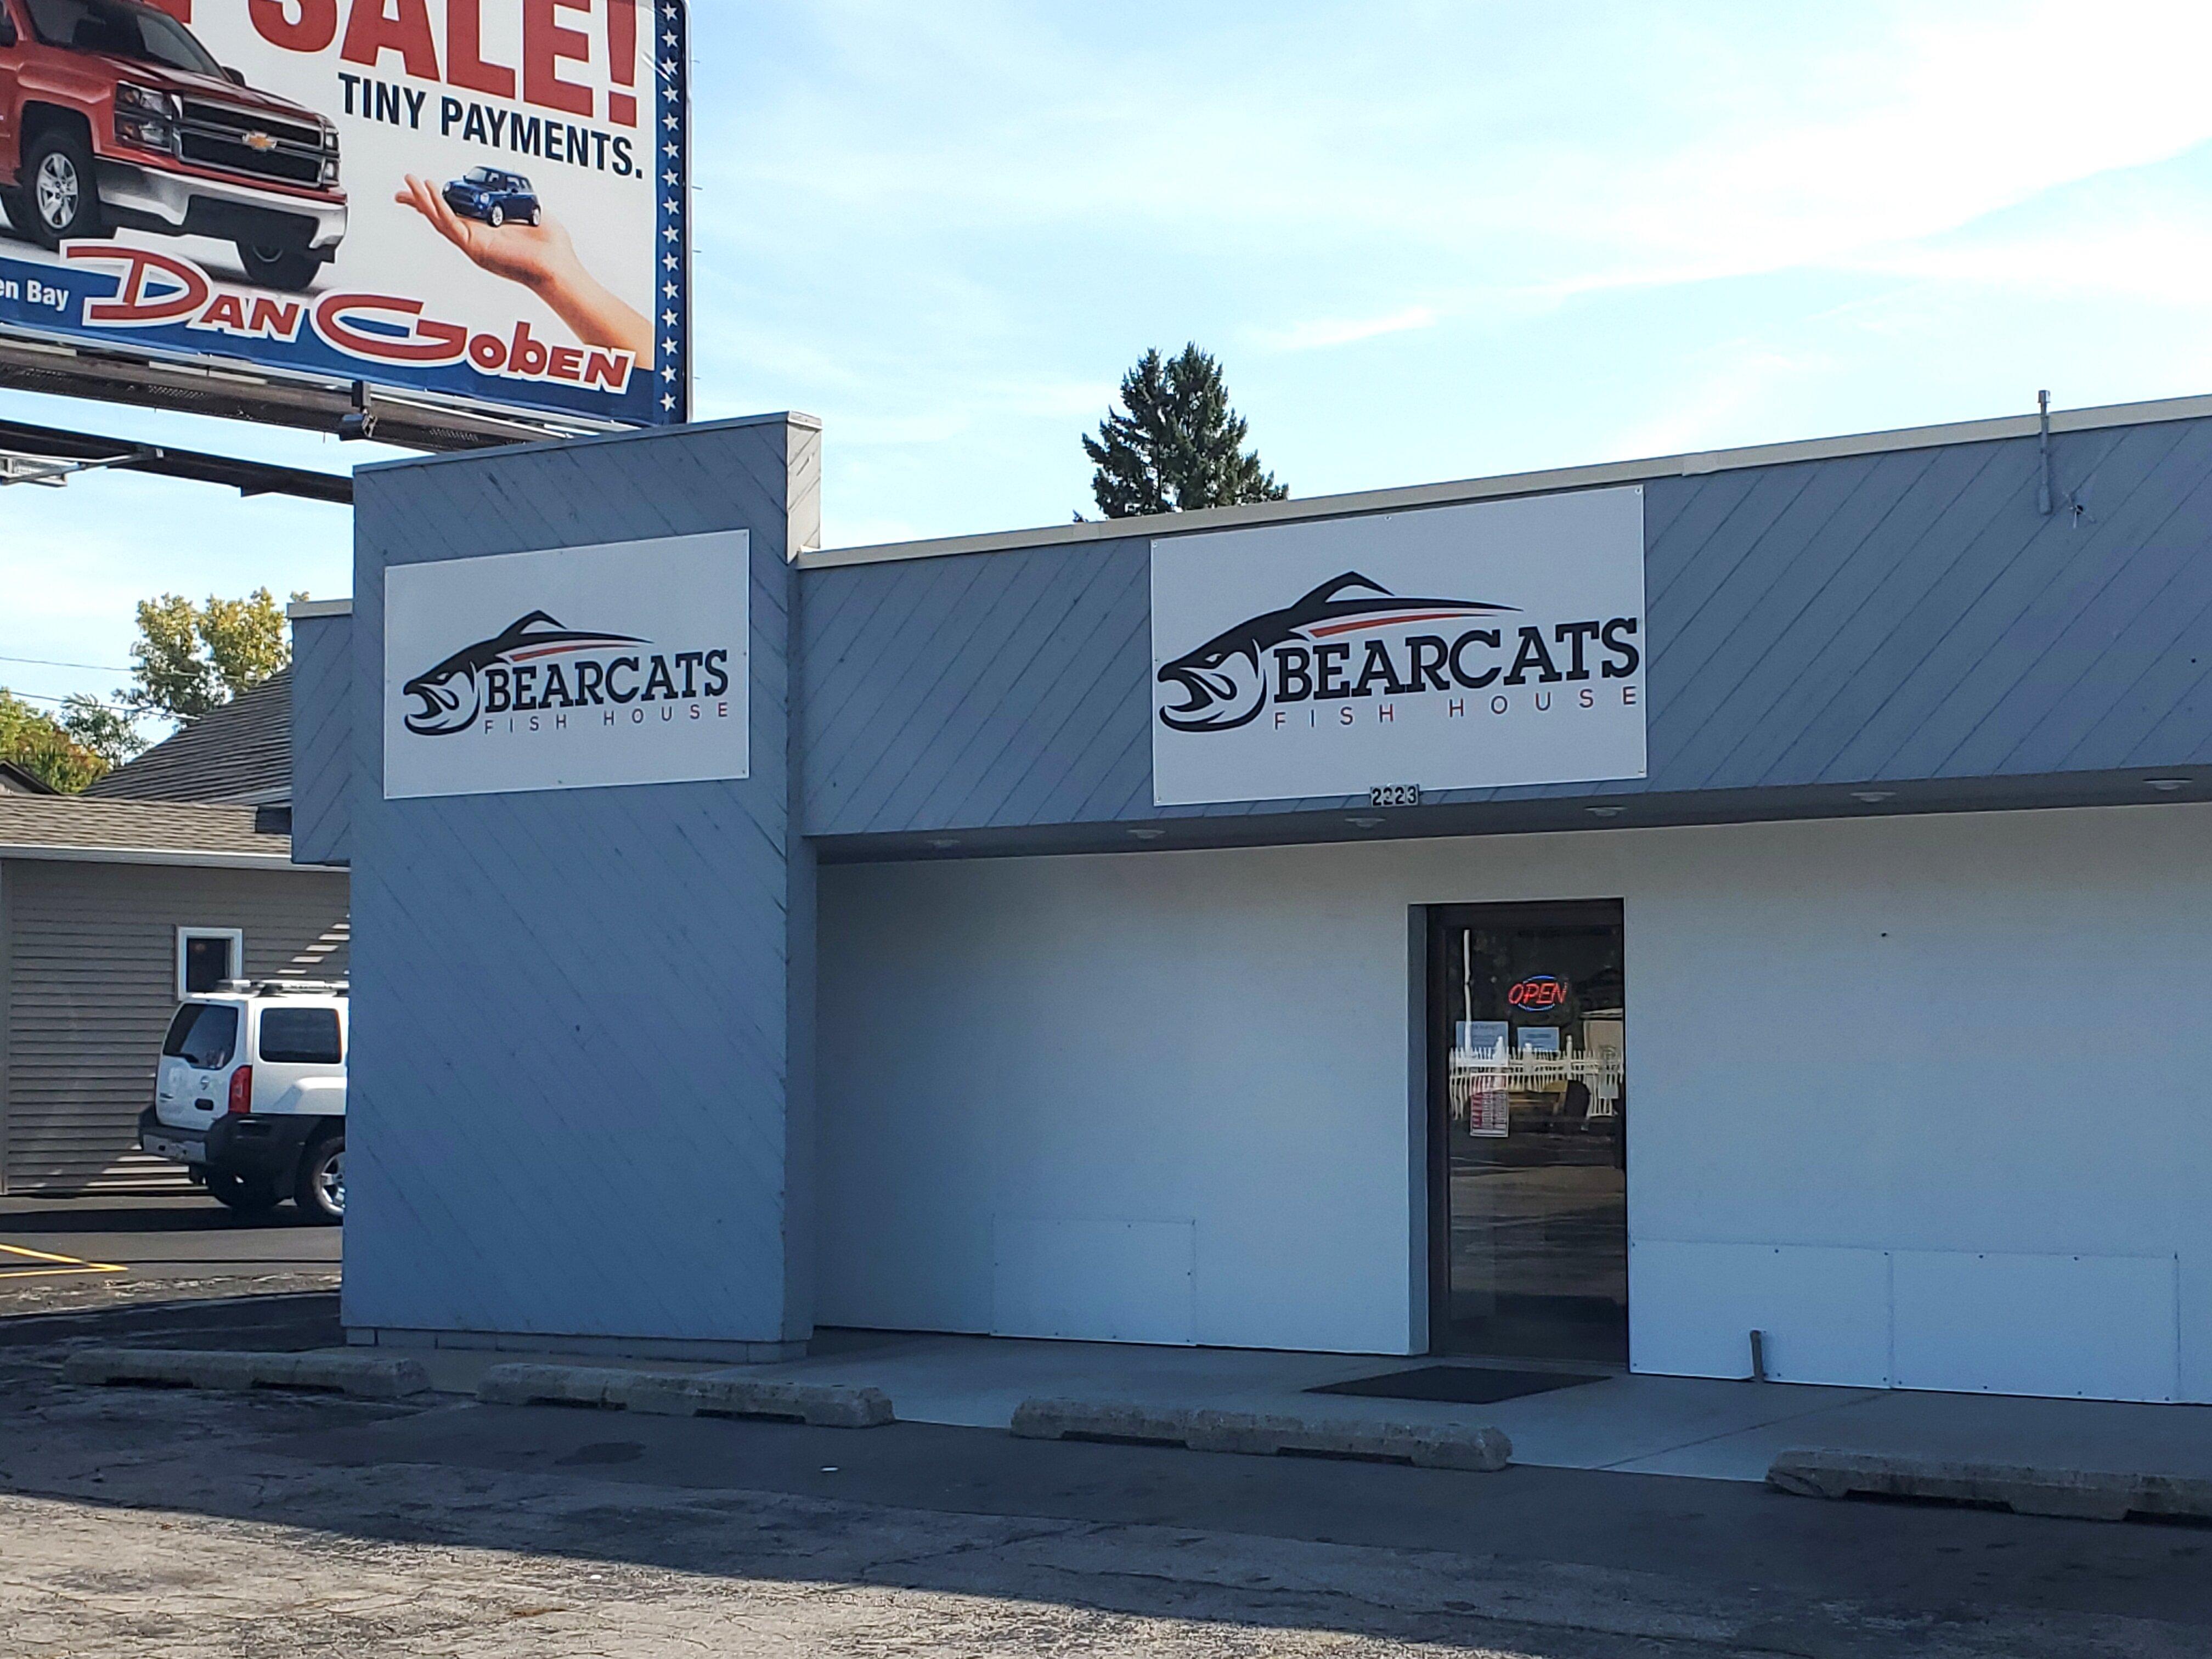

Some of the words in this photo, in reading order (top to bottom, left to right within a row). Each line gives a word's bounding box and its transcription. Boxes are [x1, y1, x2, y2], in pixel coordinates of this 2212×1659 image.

[337, 72, 427, 130] TINY
[441, 95, 643, 179] PAYMENTS.
[27, 279, 69, 312] Bay
[1273, 617, 1639, 704] BEARCATS
[484, 649, 729, 714] BEARCATS
[484, 714, 567, 735] FISH
[603, 702, 729, 727] HOUSE
[1274, 703, 1395, 731] FISH
[1448, 685, 1637, 719] HOUSE
[1372, 785, 1417, 806] 2223
[1509, 981, 1567, 1005] OPEN
